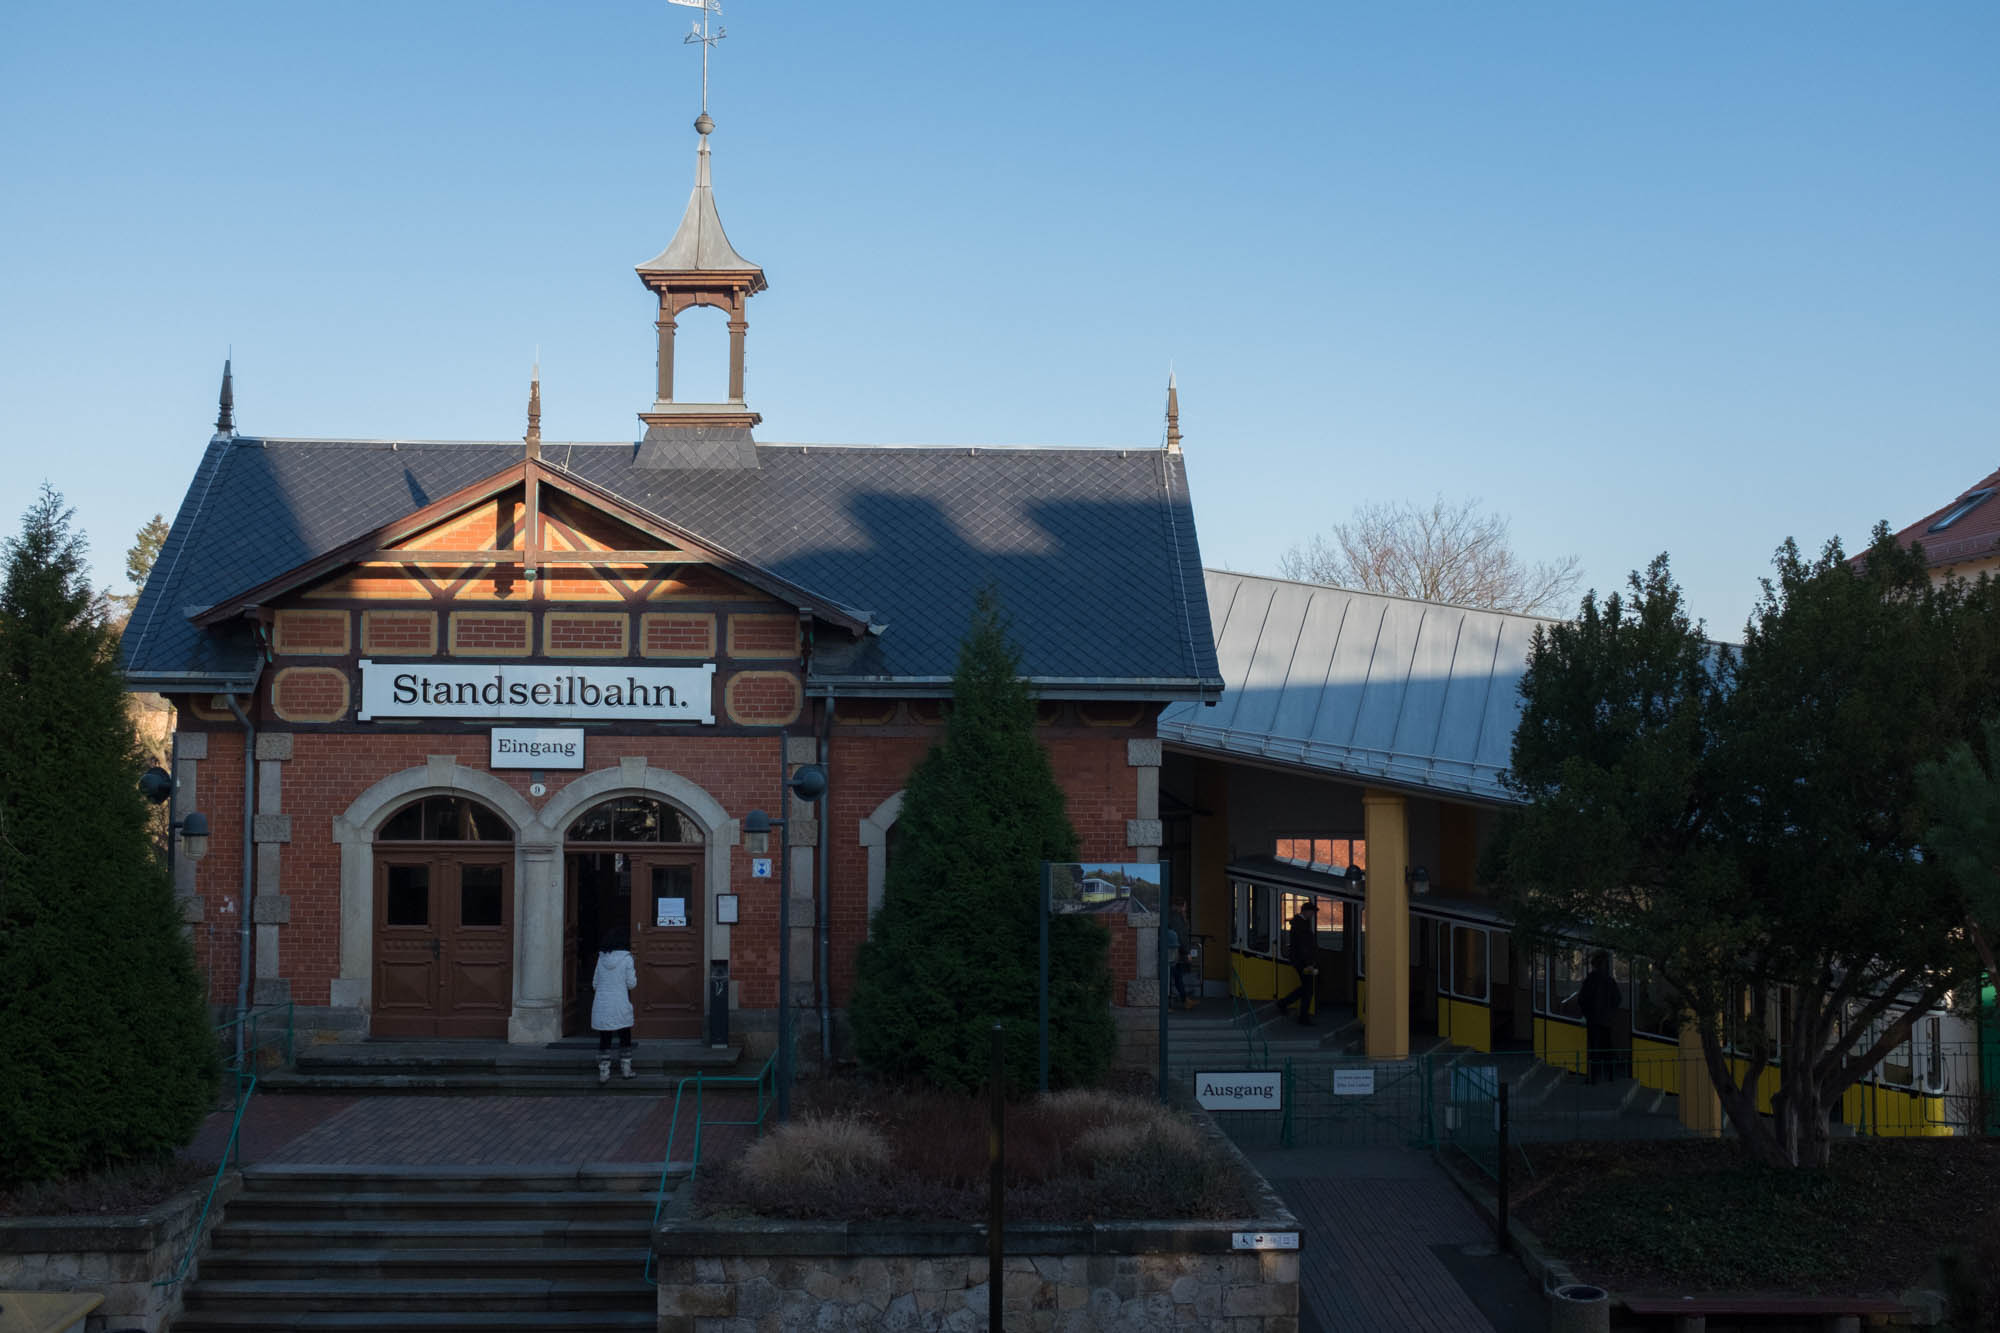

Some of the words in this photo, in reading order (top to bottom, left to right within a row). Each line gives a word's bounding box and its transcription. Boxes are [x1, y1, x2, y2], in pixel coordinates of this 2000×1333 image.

[393, 674, 689, 707] Standseilbahn.
[498, 739, 576, 756] Eingang
[1203, 1083, 1274, 1099] Ausgang
